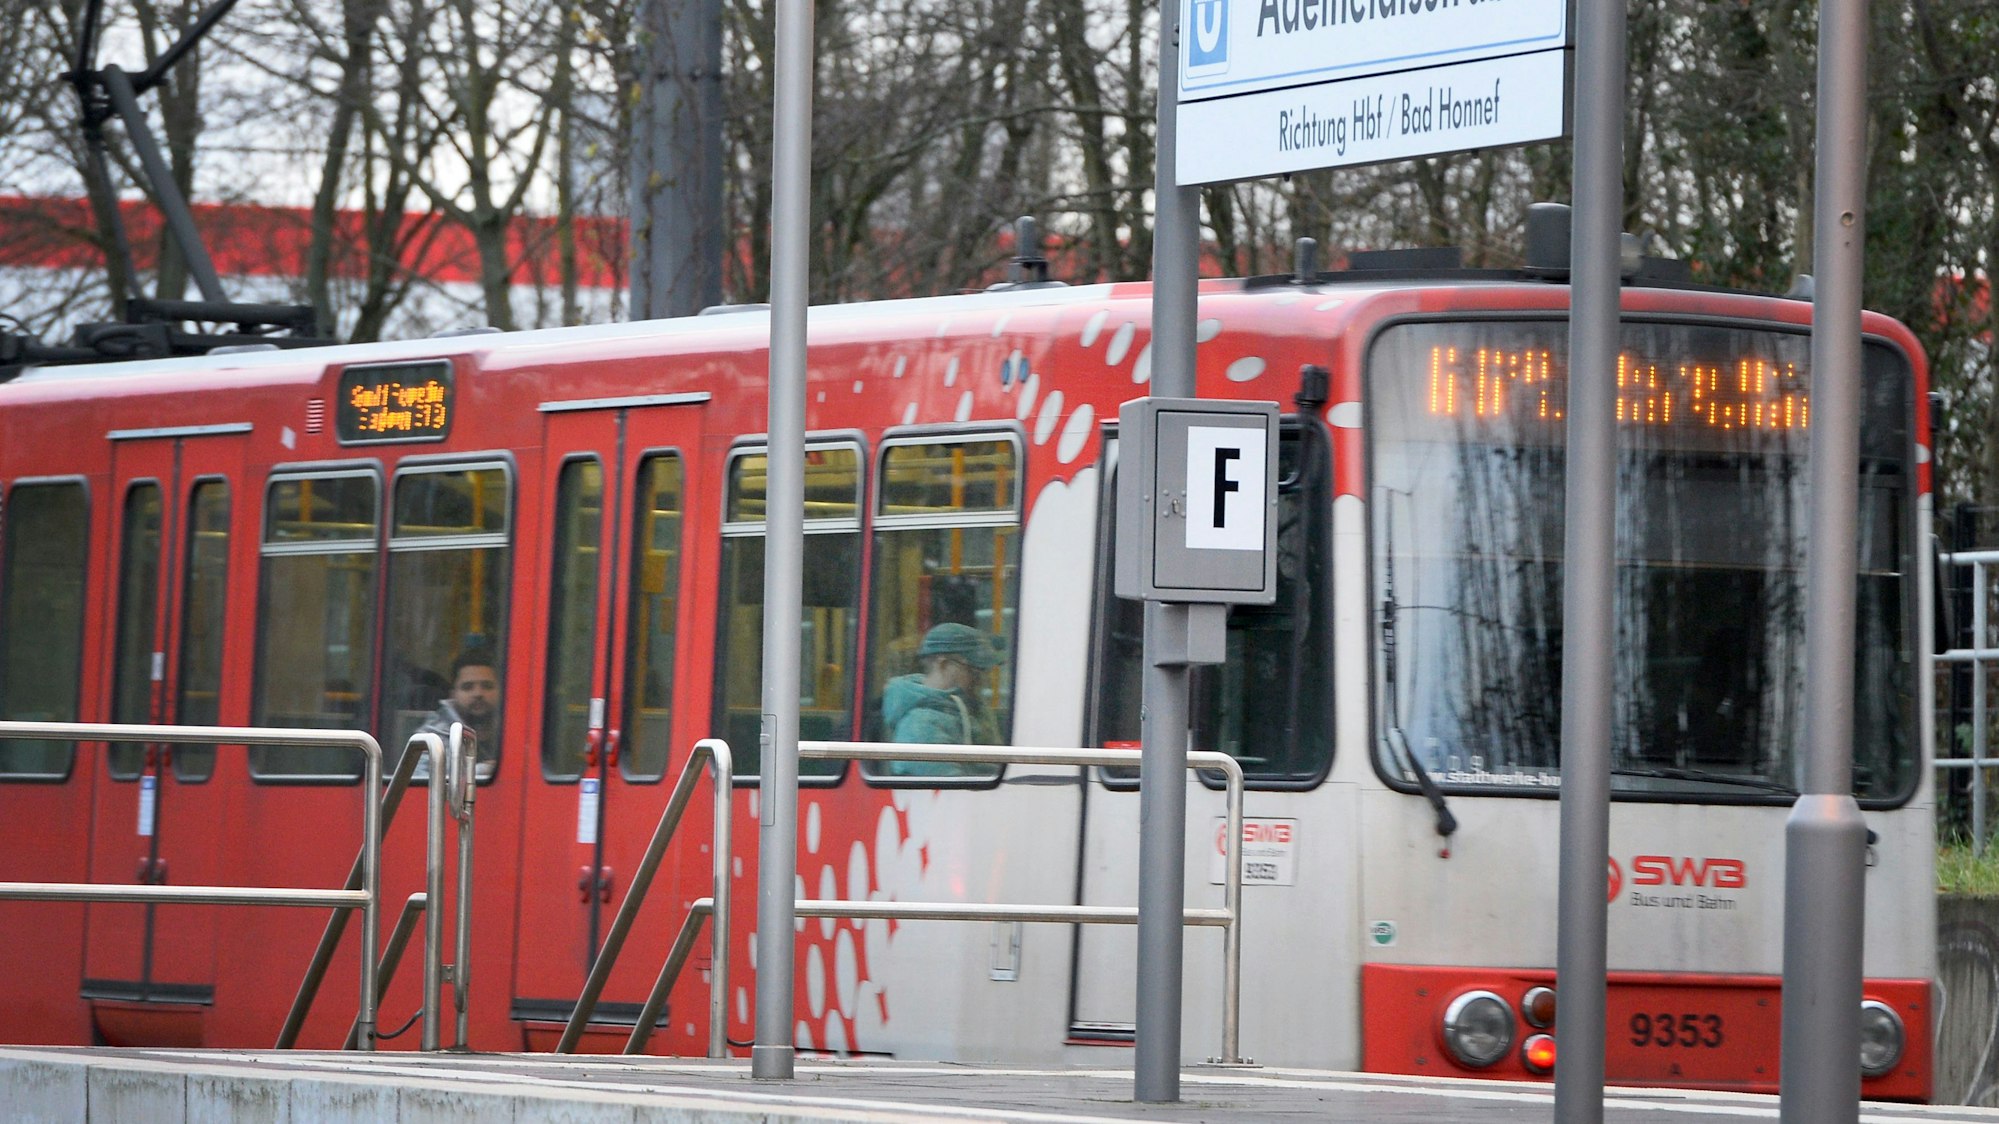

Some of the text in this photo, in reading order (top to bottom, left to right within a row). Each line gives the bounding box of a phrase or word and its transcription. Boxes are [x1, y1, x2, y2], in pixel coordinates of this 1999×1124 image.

[1279, 78, 1500, 156] Richtung Hbf / Bad Honnef
[1213, 447, 1241, 529] F
[1632, 855, 1747, 889] SWB
[1631, 892, 1660, 907] Bus
[1631, 1012, 1723, 1048] 9353
